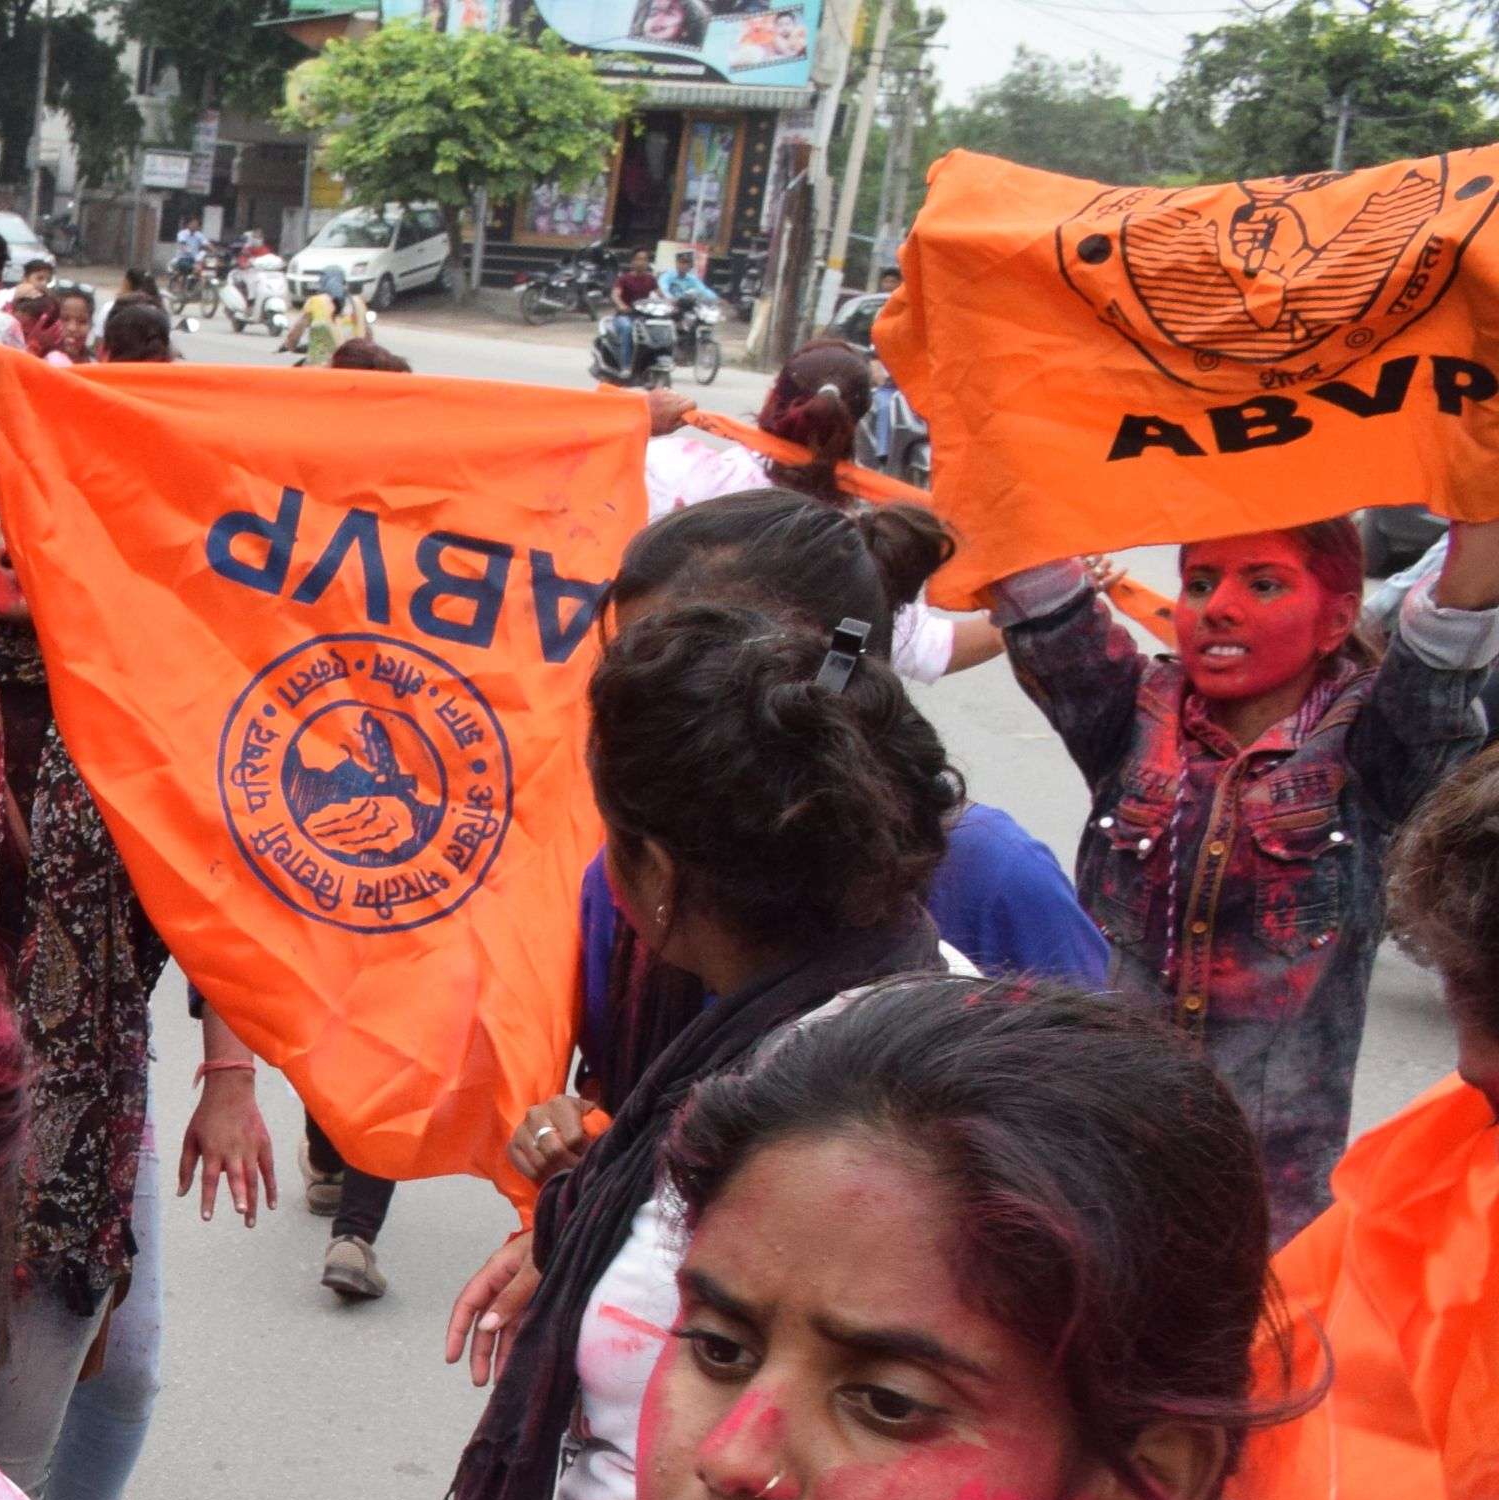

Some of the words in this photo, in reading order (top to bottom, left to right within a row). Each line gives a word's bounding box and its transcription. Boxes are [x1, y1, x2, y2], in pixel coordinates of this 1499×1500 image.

[1107, 355, 1499, 462] ABVP
[206, 485, 613, 663] ABVP
[277, 649, 350, 709] एकता
[370, 653, 427, 698] शील
[352, 868, 450, 920] भारतीय
